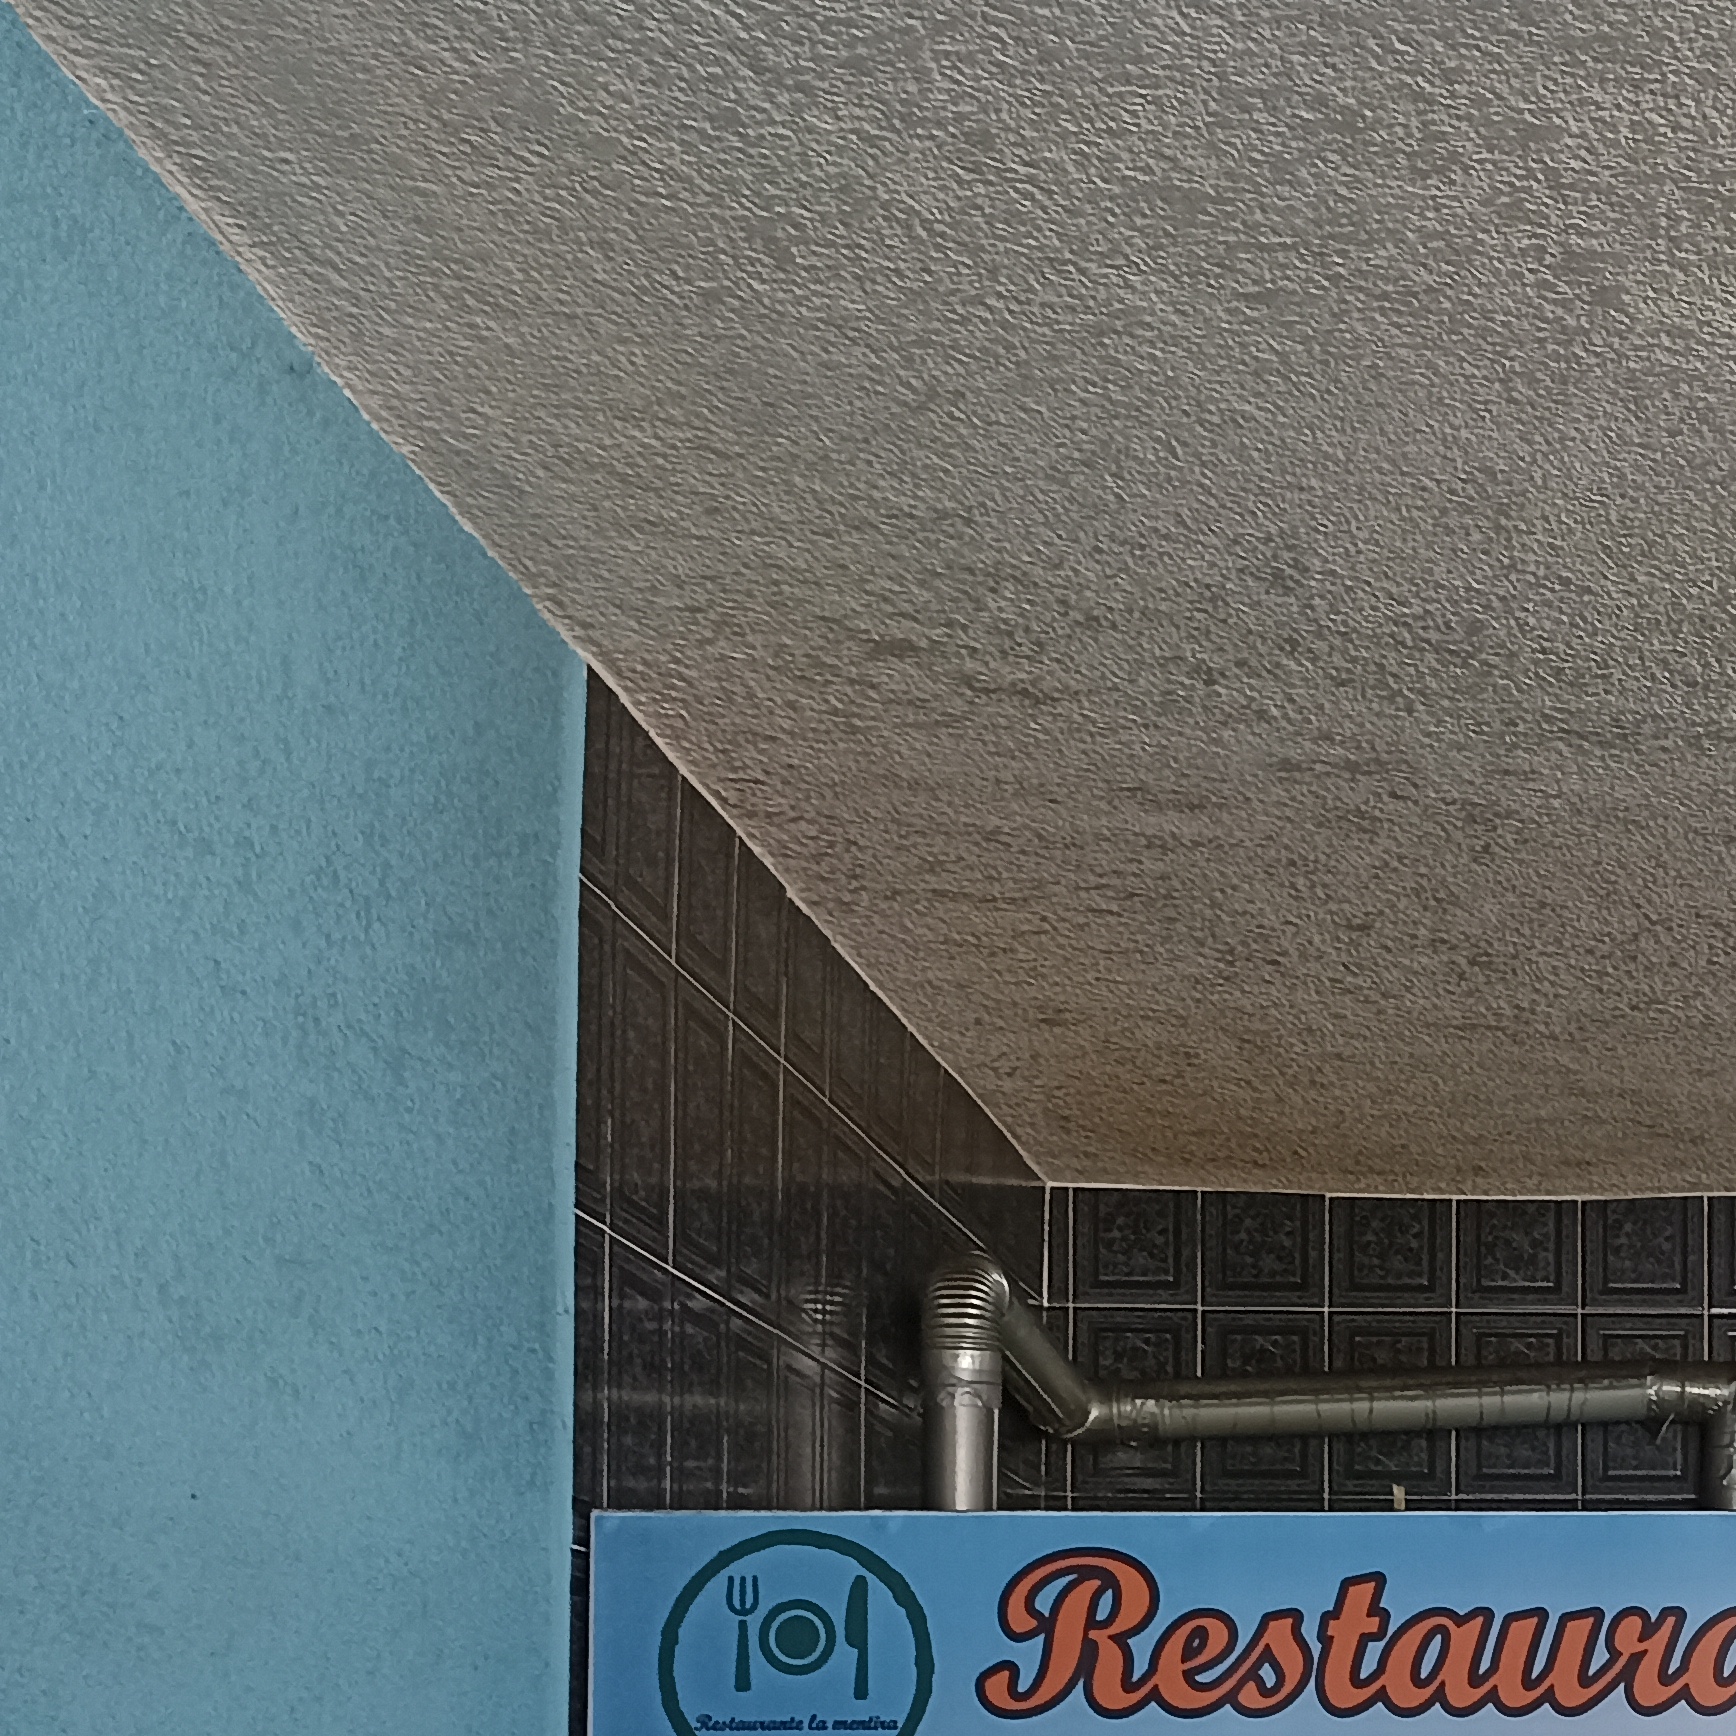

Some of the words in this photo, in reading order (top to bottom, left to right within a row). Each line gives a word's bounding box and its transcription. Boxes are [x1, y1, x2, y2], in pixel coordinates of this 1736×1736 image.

[694, 1713, 804, 1731] Restaurante
[808, 1713, 829, 1731] la
[832, 1715, 899, 1731] mentira
